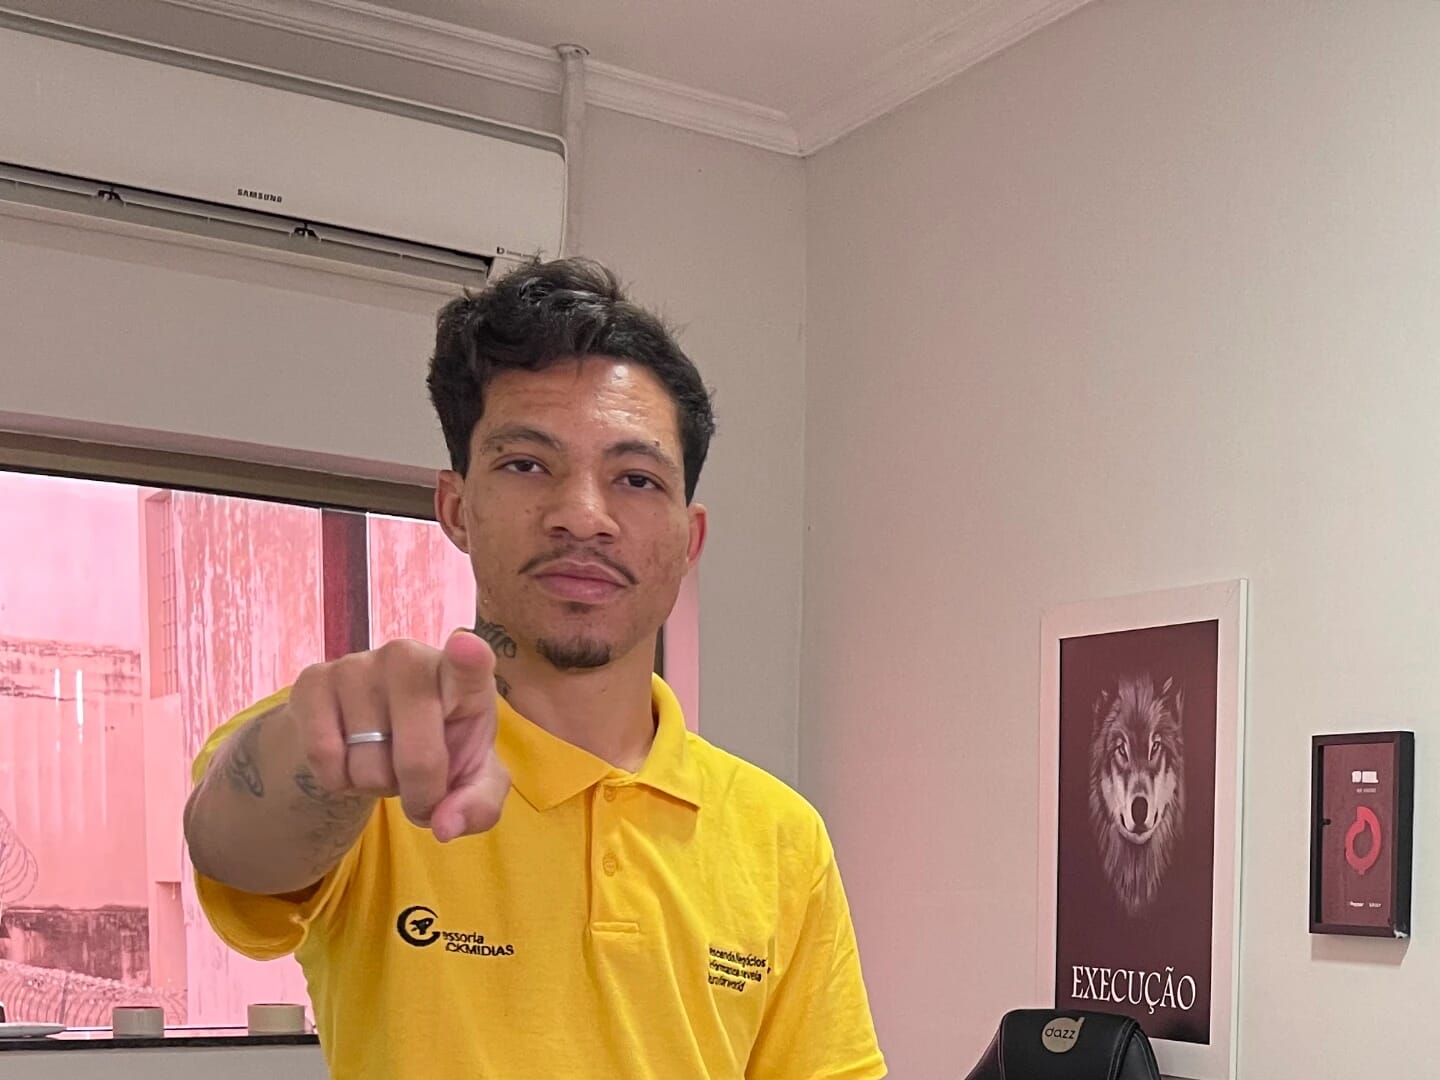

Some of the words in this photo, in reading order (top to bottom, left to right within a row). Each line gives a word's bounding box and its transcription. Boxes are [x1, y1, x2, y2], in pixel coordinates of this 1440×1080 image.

[237, 189, 282, 203] SAMSUNG
[1071, 965, 1196, 1015] EXECUÇÃO
[1045, 1026, 1076, 1040] dazz
